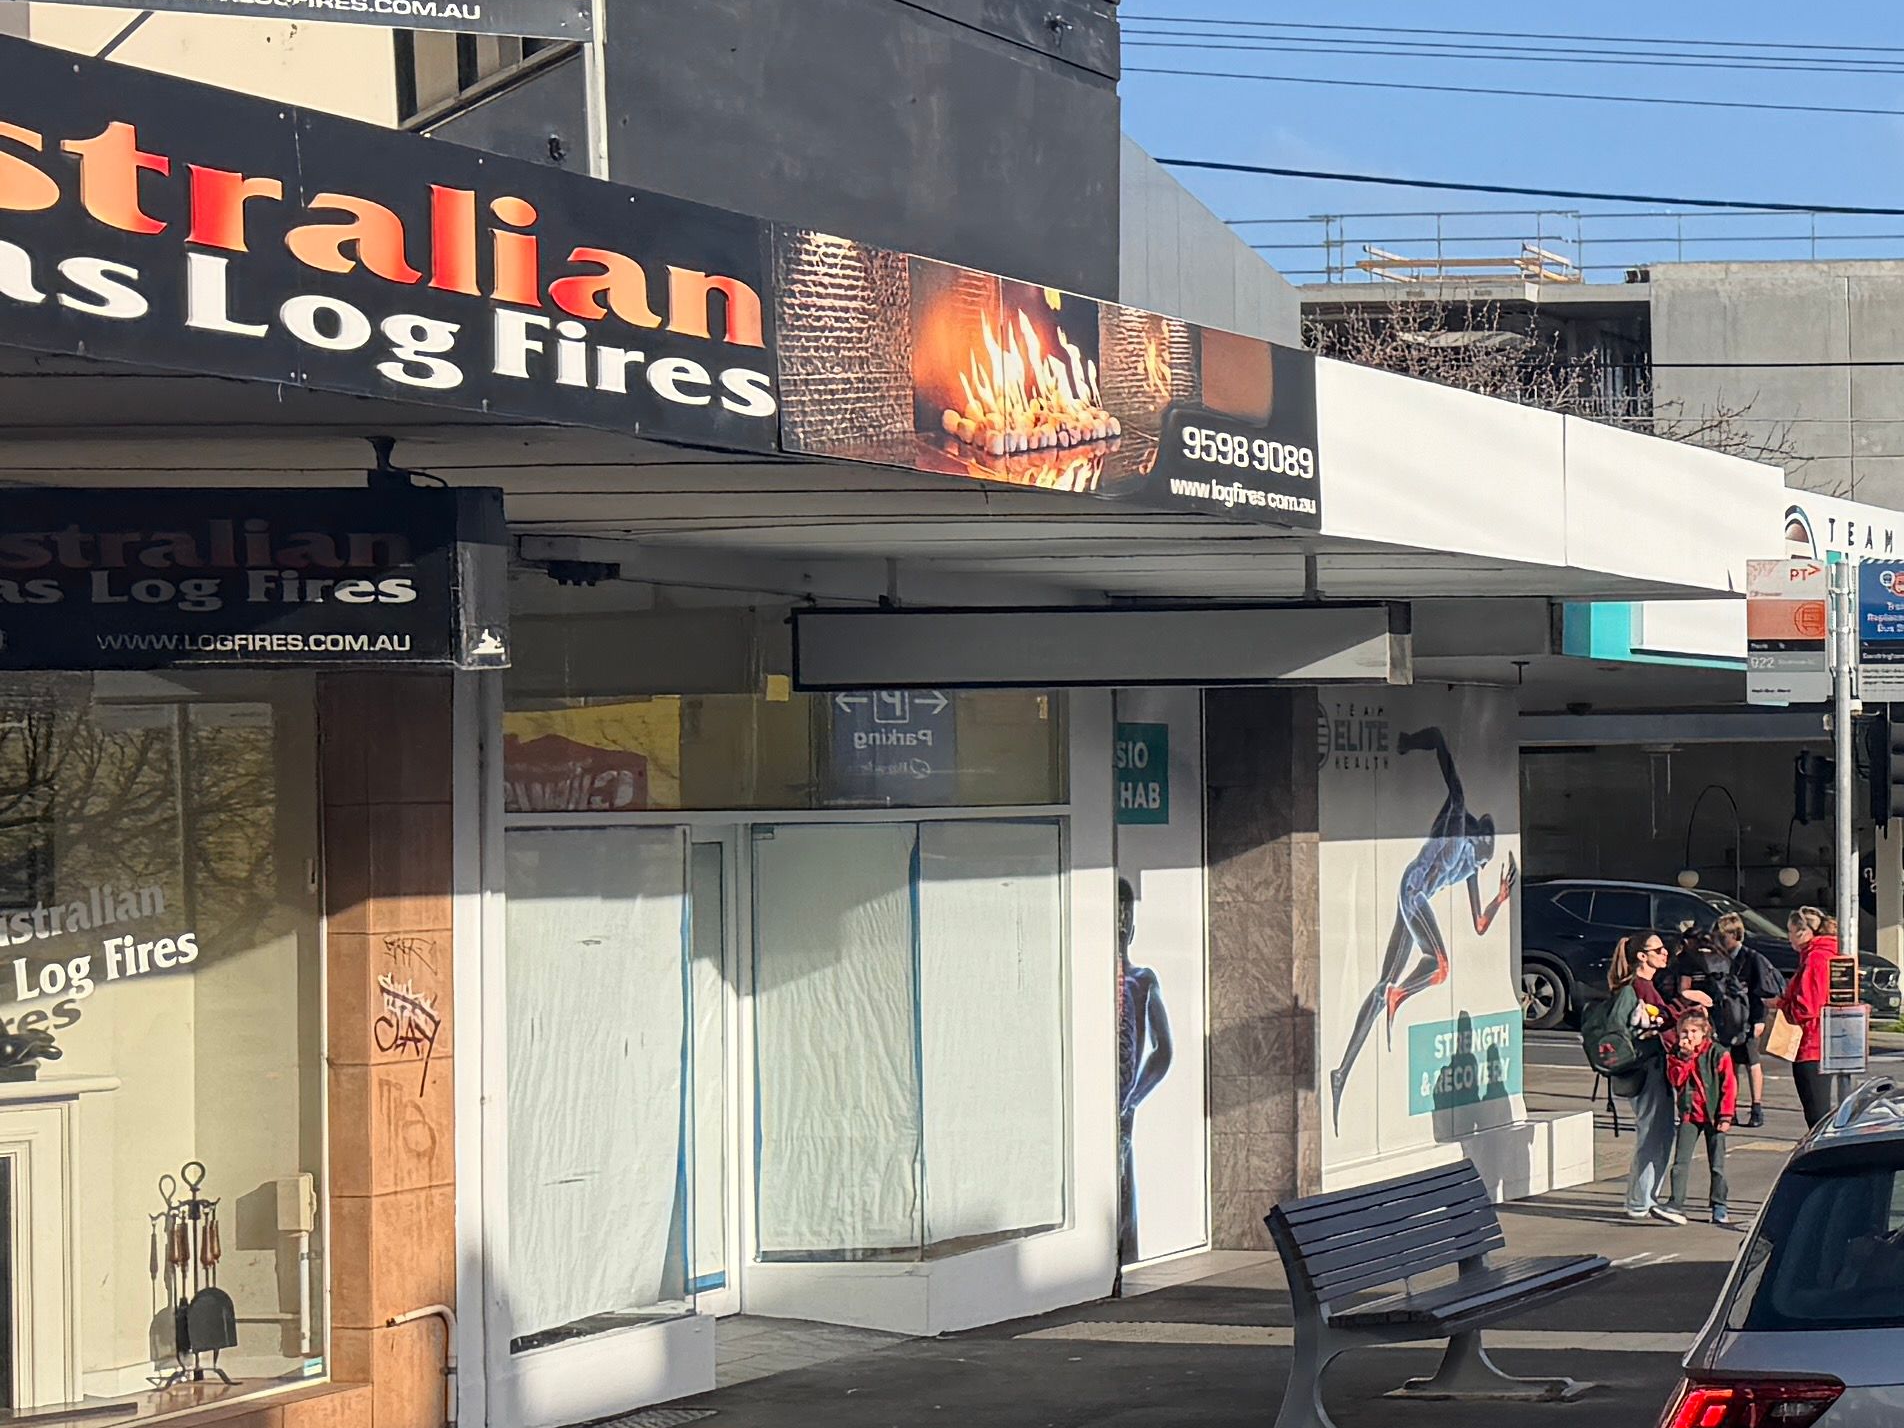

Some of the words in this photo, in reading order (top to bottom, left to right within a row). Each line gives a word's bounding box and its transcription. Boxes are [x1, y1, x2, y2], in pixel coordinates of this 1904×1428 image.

[185, 252, 463, 389] Log
[490, 308, 777, 418] Fires
[1182, 426, 1249, 468] 9598
[1252, 439, 1314, 479] 9089
[1828, 517, 1894, 554] TEAM
[91, 570, 224, 613] Log
[246, 570, 417, 604] Fires
[97, 634, 411, 652] WWW.LOGFIRES.COM.AU
[1334, 721, 1389, 751] ELITE
[1335, 756, 1389, 770] HEALTH
[13, 956, 95, 1000] Log
[103, 932, 199, 981] Fires
[1434, 1024, 1510, 1059] STRENGTH
[1420, 1072, 1431, 1097] &
[1434, 1057, 1510, 1093] RECOVERY
